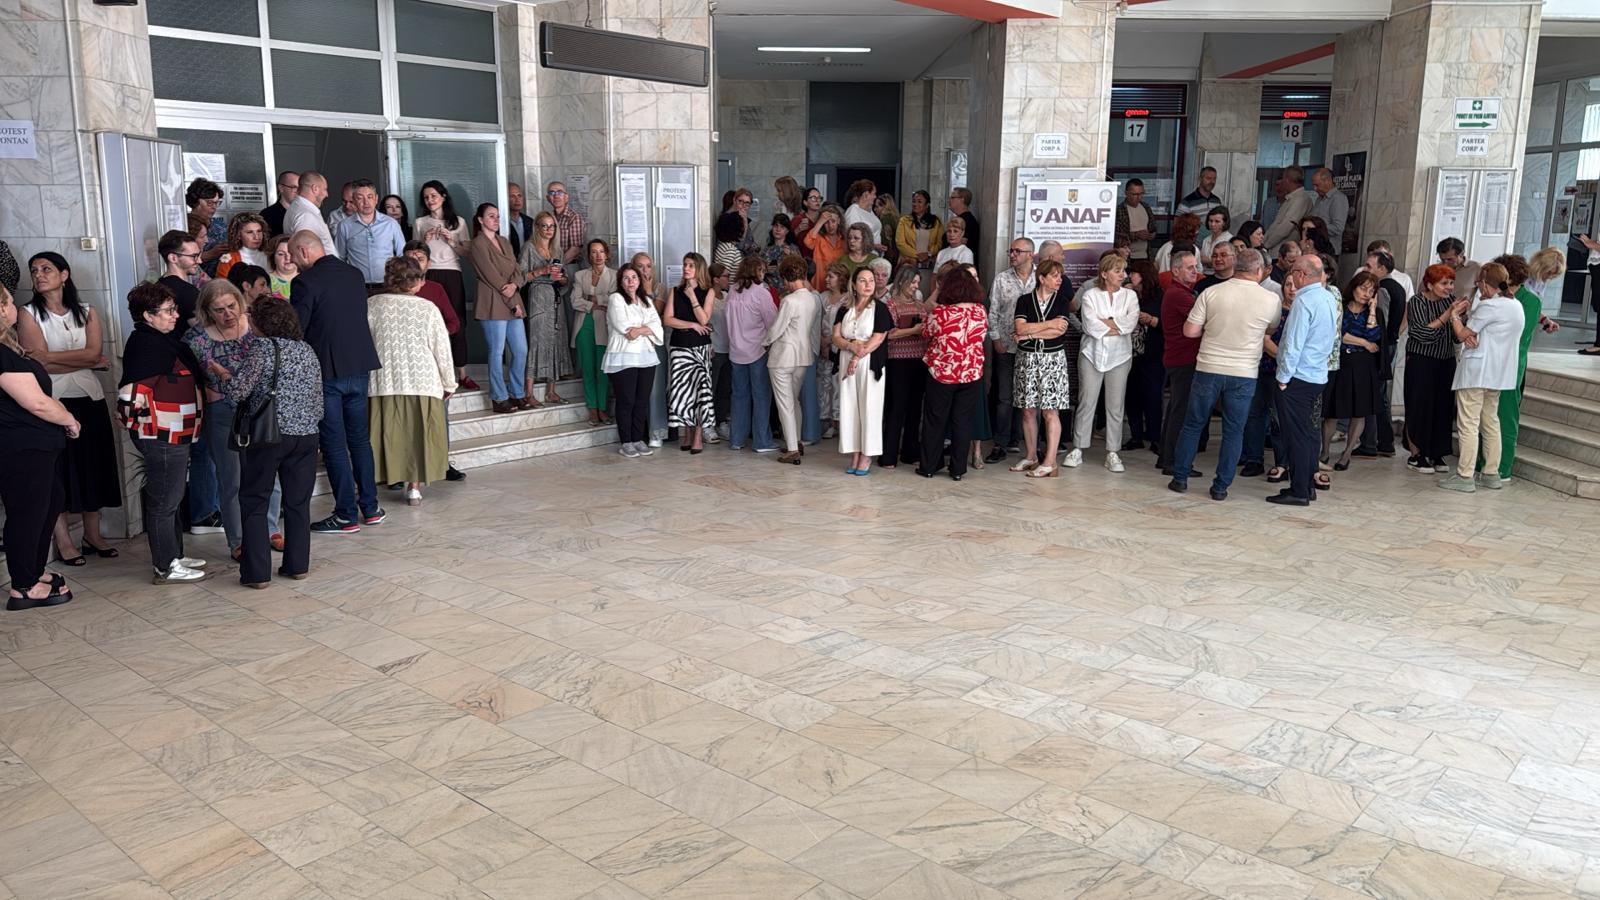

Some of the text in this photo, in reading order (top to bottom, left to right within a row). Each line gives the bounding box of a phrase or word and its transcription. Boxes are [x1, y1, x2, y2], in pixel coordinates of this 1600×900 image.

[0, 127, 28, 135] OTEST
[1128, 124, 1144, 137] 17
[1284, 124, 1299, 138] 18
[1044, 208, 1112, 223] ANAF
